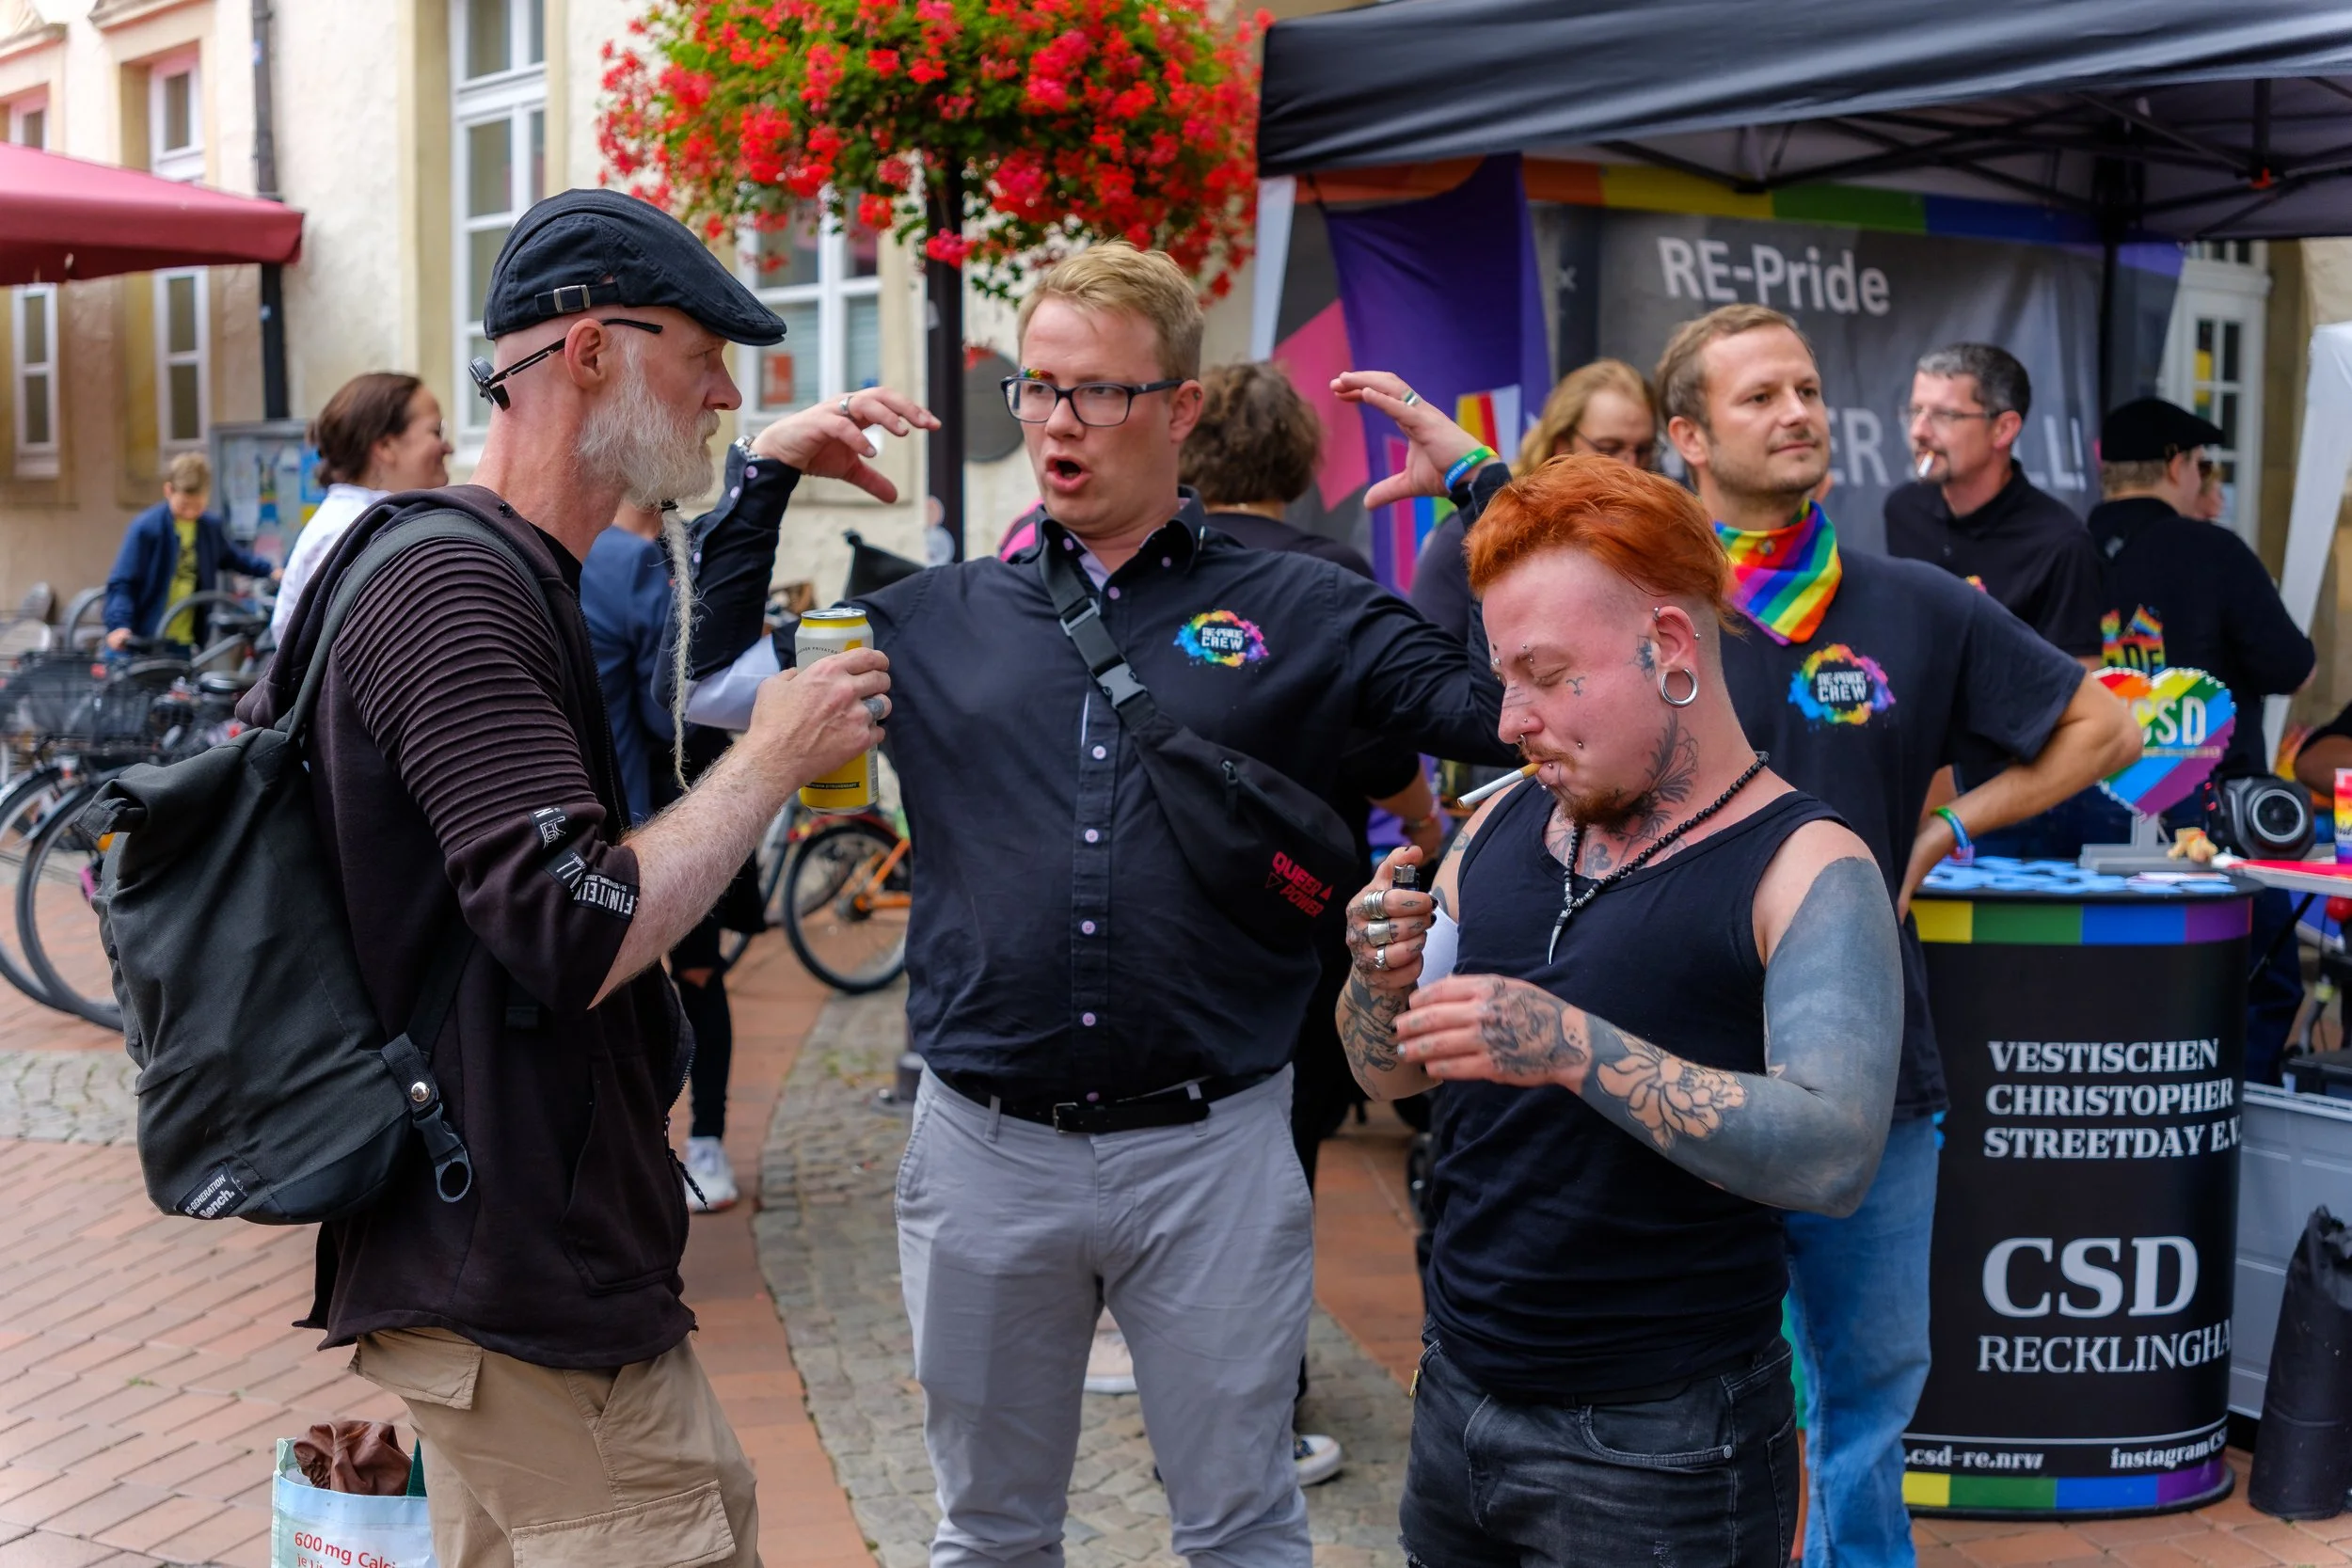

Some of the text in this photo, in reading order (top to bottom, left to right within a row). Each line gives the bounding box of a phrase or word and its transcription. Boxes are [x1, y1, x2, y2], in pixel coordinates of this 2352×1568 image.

[1658, 235, 1890, 315] RE-Pride
[1201, 636, 1243, 651] CREW
[1818, 684, 1867, 703] CREW
[1272, 850, 1323, 897] QUEER
[1279, 883, 1325, 918] POWER
[1987, 1038, 2219, 1073] VESTISCHEN
[1985, 1078, 2234, 1117] CHRISTOPHER
[1983, 1124, 2205, 1159] STREETDAY
[1981, 1235, 2200, 1319] CSD
[294, 1531, 322, 1552] 600
[325, 1544, 352, 1566] mg
